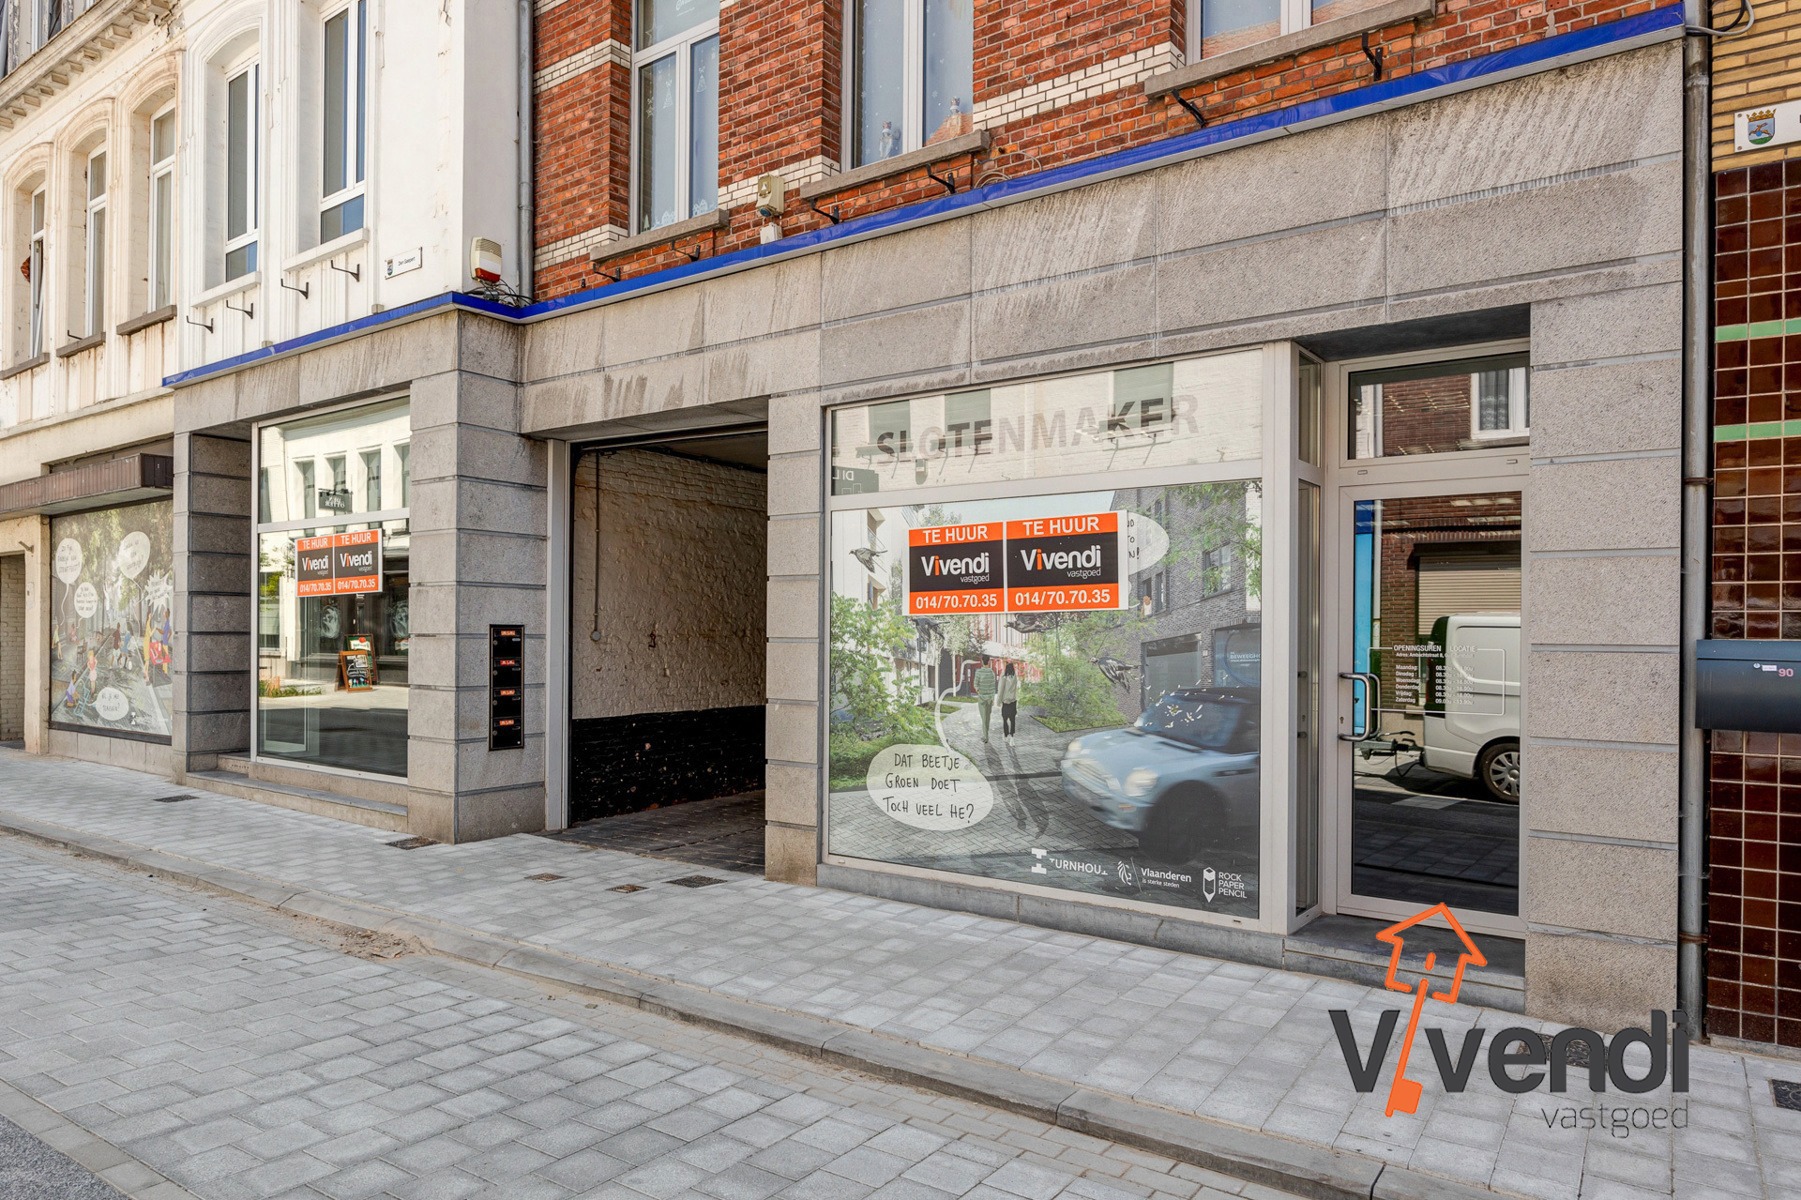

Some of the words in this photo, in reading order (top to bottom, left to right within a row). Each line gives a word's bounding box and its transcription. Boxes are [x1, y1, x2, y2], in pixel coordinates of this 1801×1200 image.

[875, 394, 1199, 462] SLOTENMAKER
[923, 529, 941, 543] TE
[946, 525, 988, 542] HUUR
[1023, 521, 1044, 536] TE
[1049, 517, 1100, 534] HUUR
[303, 539, 311, 549] TE
[312, 537, 329, 549] HUUR
[341, 535, 351, 545] TE
[352, 532, 372, 543] HUUR
[302, 555, 329, 571] Vivendi
[340, 550, 373, 567] Vivendi
[921, 552, 990, 576] Vivendi
[1020, 545, 1101, 571] Vivendi
[960, 573, 990, 584] vastgoed
[1066, 567, 1101, 579] vastgoed
[300, 581, 332, 593] 014/70.70.35
[337, 578, 376, 591] 014/70.70.35
[916, 591, 997, 609] 014/70.70.35
[1015, 589, 1111, 606] 014/70.70.35
[1778, 668, 1794, 677] 90
[894, 753, 913, 768] DAT
[922, 753, 960, 771] BEETJE
[885, 772, 919, 789] GROEN
[931, 777, 961, 793] DOET
[916, 804, 943, 817] VEEL
[1140, 868, 1192, 883] Vlaanderen
[1218, 872, 1242, 881] ROCK
[1218, 880, 1245, 890] PAPER
[1218, 888, 1248, 899] PENCIL
